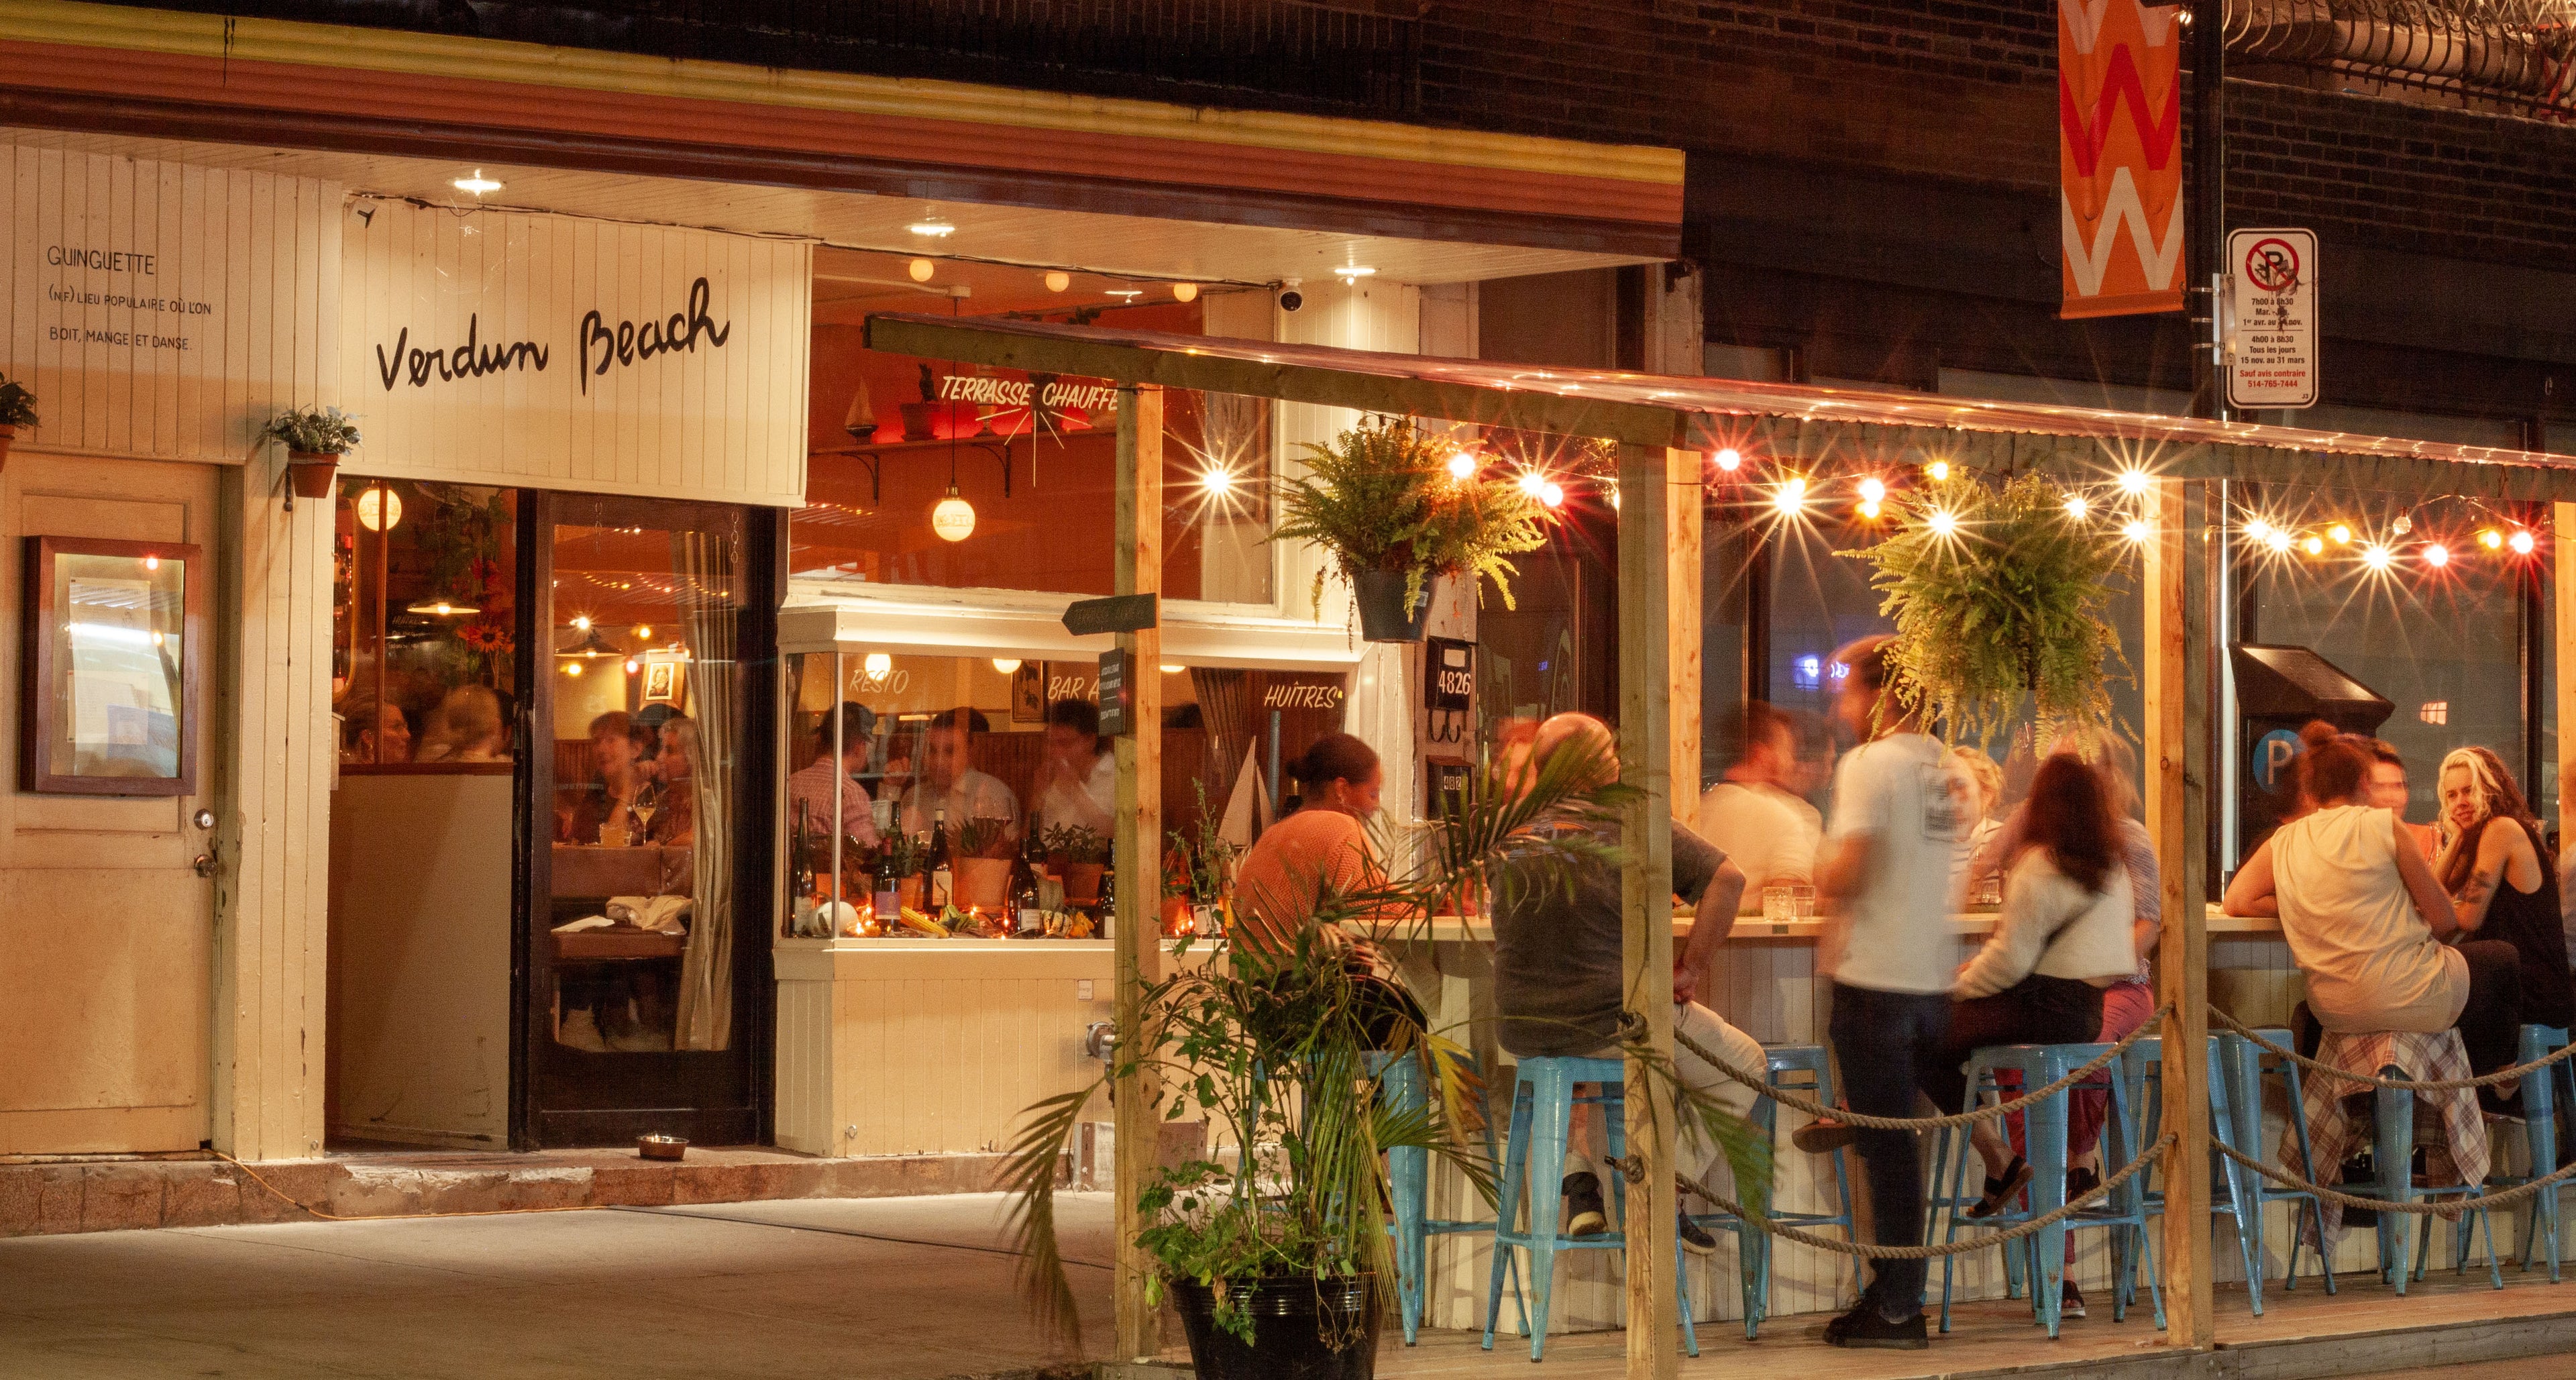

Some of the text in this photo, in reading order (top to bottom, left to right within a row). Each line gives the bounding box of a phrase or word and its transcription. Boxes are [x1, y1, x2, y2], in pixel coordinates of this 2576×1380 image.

[47, 246, 155, 274] GUINGUETTE
[77, 292, 100, 305] LIEU
[104, 295, 165, 311] POPULAIRE
[170, 297, 185, 313] OÙ
[189, 301, 211, 315] L'ON
[50, 327, 193, 350] BOIT, MANGE ET DANSE.
[376, 277, 731, 396] Verdun Beach
[2270, 335, 2275, 343] à
[2278, 346, 2296, 354] jours
[941, 376, 1034, 406] TERRASSE
[849, 669, 909, 694] RESTO
[1048, 676, 1085, 700] BAR
[1439, 670, 1471, 695] 4826
[1264, 680, 1338, 708] HUÎTRES
[1444, 776, 1468, 790] 482
